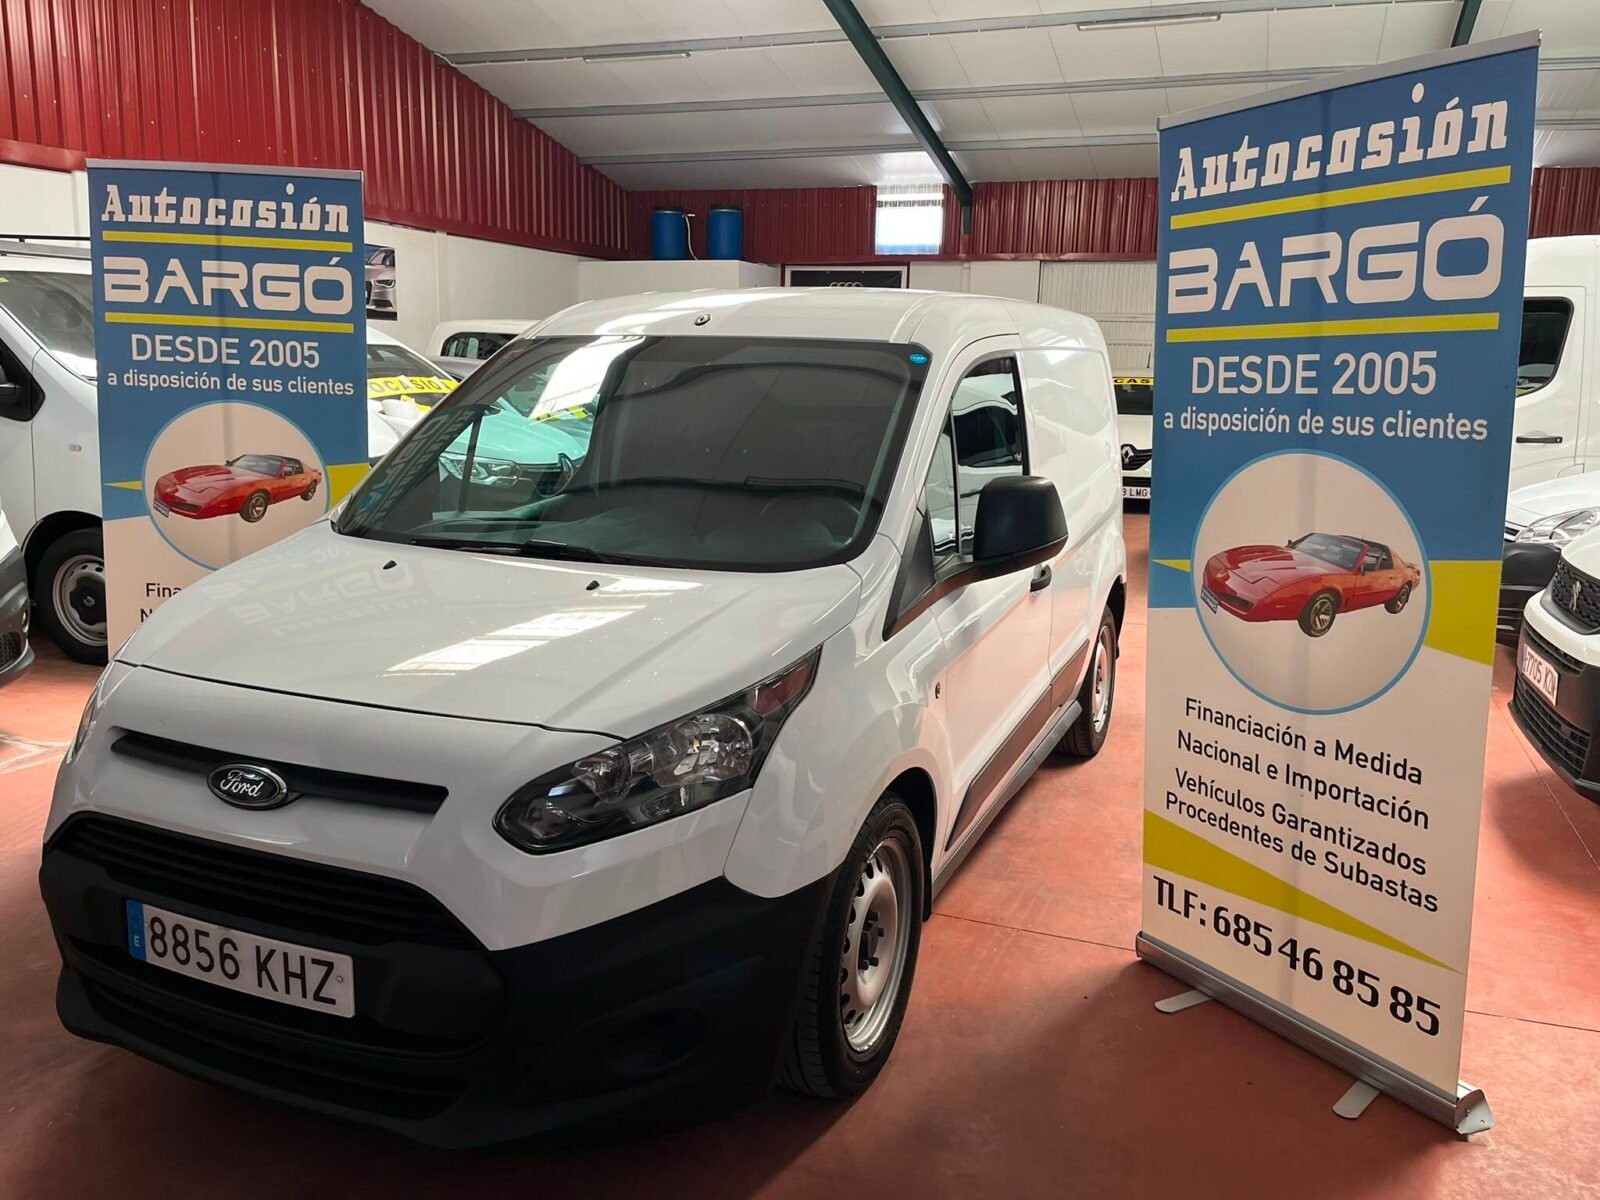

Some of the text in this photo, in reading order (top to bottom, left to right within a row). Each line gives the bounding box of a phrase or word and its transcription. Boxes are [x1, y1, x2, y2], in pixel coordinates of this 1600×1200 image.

[1170, 82, 1508, 202] Autocasión
[101, 182, 349, 233] Autocasión
[103, 256, 353, 315] BARGÓ
[1167, 195, 1505, 314] BARGÓ
[107, 369, 354, 396] a disposición de sus clientes
[131, 333, 320, 368] DESDE 2005
[369, 378, 453, 392] OCASIO
[1191, 350, 1437, 395] DESDE 2005
[1163, 406, 1488, 441] a disposición de sus clientes
[1185, 697, 1423, 785] Financiación a Medida
[220, 769, 264, 797] Ford
[1177, 729, 1430, 830] Nacional e Importación
[1166, 791, 1439, 912] Procedentes de Subastas
[1175, 767, 1427, 876] Vehículos Garantizados
[150, 916, 241, 980] 8856
[255, 944, 337, 1006] KHZ
[1153, 875, 1441, 1037] TLF: 685 46 85 85
